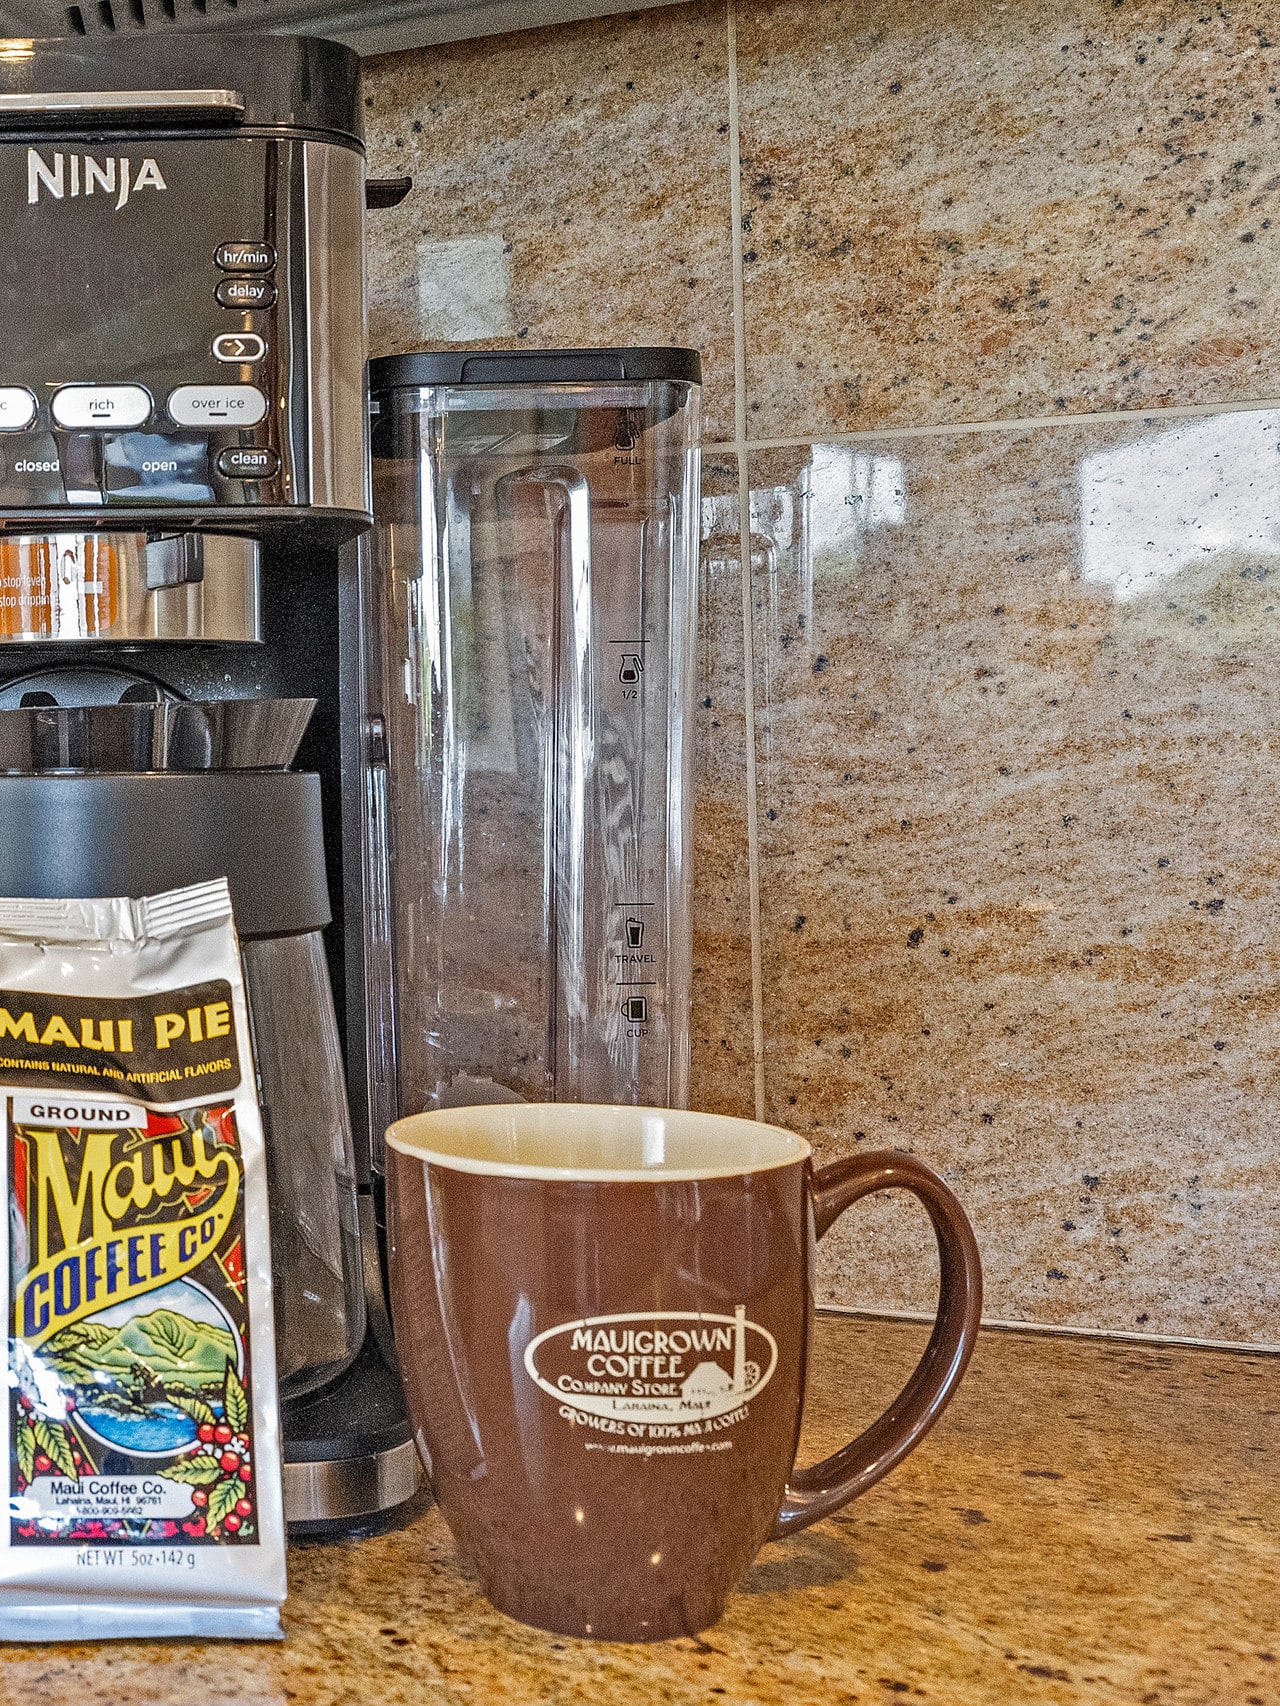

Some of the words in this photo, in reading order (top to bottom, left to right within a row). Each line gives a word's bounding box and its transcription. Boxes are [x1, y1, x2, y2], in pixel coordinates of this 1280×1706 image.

[27, 148, 167, 210] NINJA
[223, 249, 268, 265] hr/min
[228, 284, 265, 300] delay
[88, 397, 115, 411] rich
[191, 399, 220, 410] over
[224, 396, 246, 410] ice
[14, 459, 61, 473] closed
[231, 452, 268, 466] clean
[614, 456, 641, 465] FULL
[141, 460, 178, 476] open
[3, 575, 21, 590] stop
[0, 594, 16, 608] stop
[18, 593, 51, 607] drippin
[621, 690, 638, 699] 1/2
[615, 954, 657, 963] TRAVEL
[154, 1001, 231, 1050] PIE
[626, 1029, 649, 1038] CUP
[51, 1062, 101, 1077] NATURAL
[102, 1066, 125, 1080] AND
[126, 1069, 183, 1084] ARTIFICIAL
[184, 1058, 232, 1079] FLAVORS
[30, 1104, 131, 1122] GROUND
[25, 1128, 239, 1264] Maui
[23, 1233, 167, 1338] COFFEE
[570, 1327, 734, 1354] MAUIGROWN
[587, 1354, 686, 1378] COFFEE
[627, 1423, 647, 1437] OF
[648, 1424, 681, 1439] 100%
[50, 1481, 84, 1495] Maui
[88, 1481, 139, 1495] Coffee
[142, 1481, 167, 1495] Co.
[55, 1497, 93, 1506] Lahaina,
[77, 1551, 100, 1565] NET
[103, 1551, 124, 1565] WT
[187, 1553, 195, 1569] g
